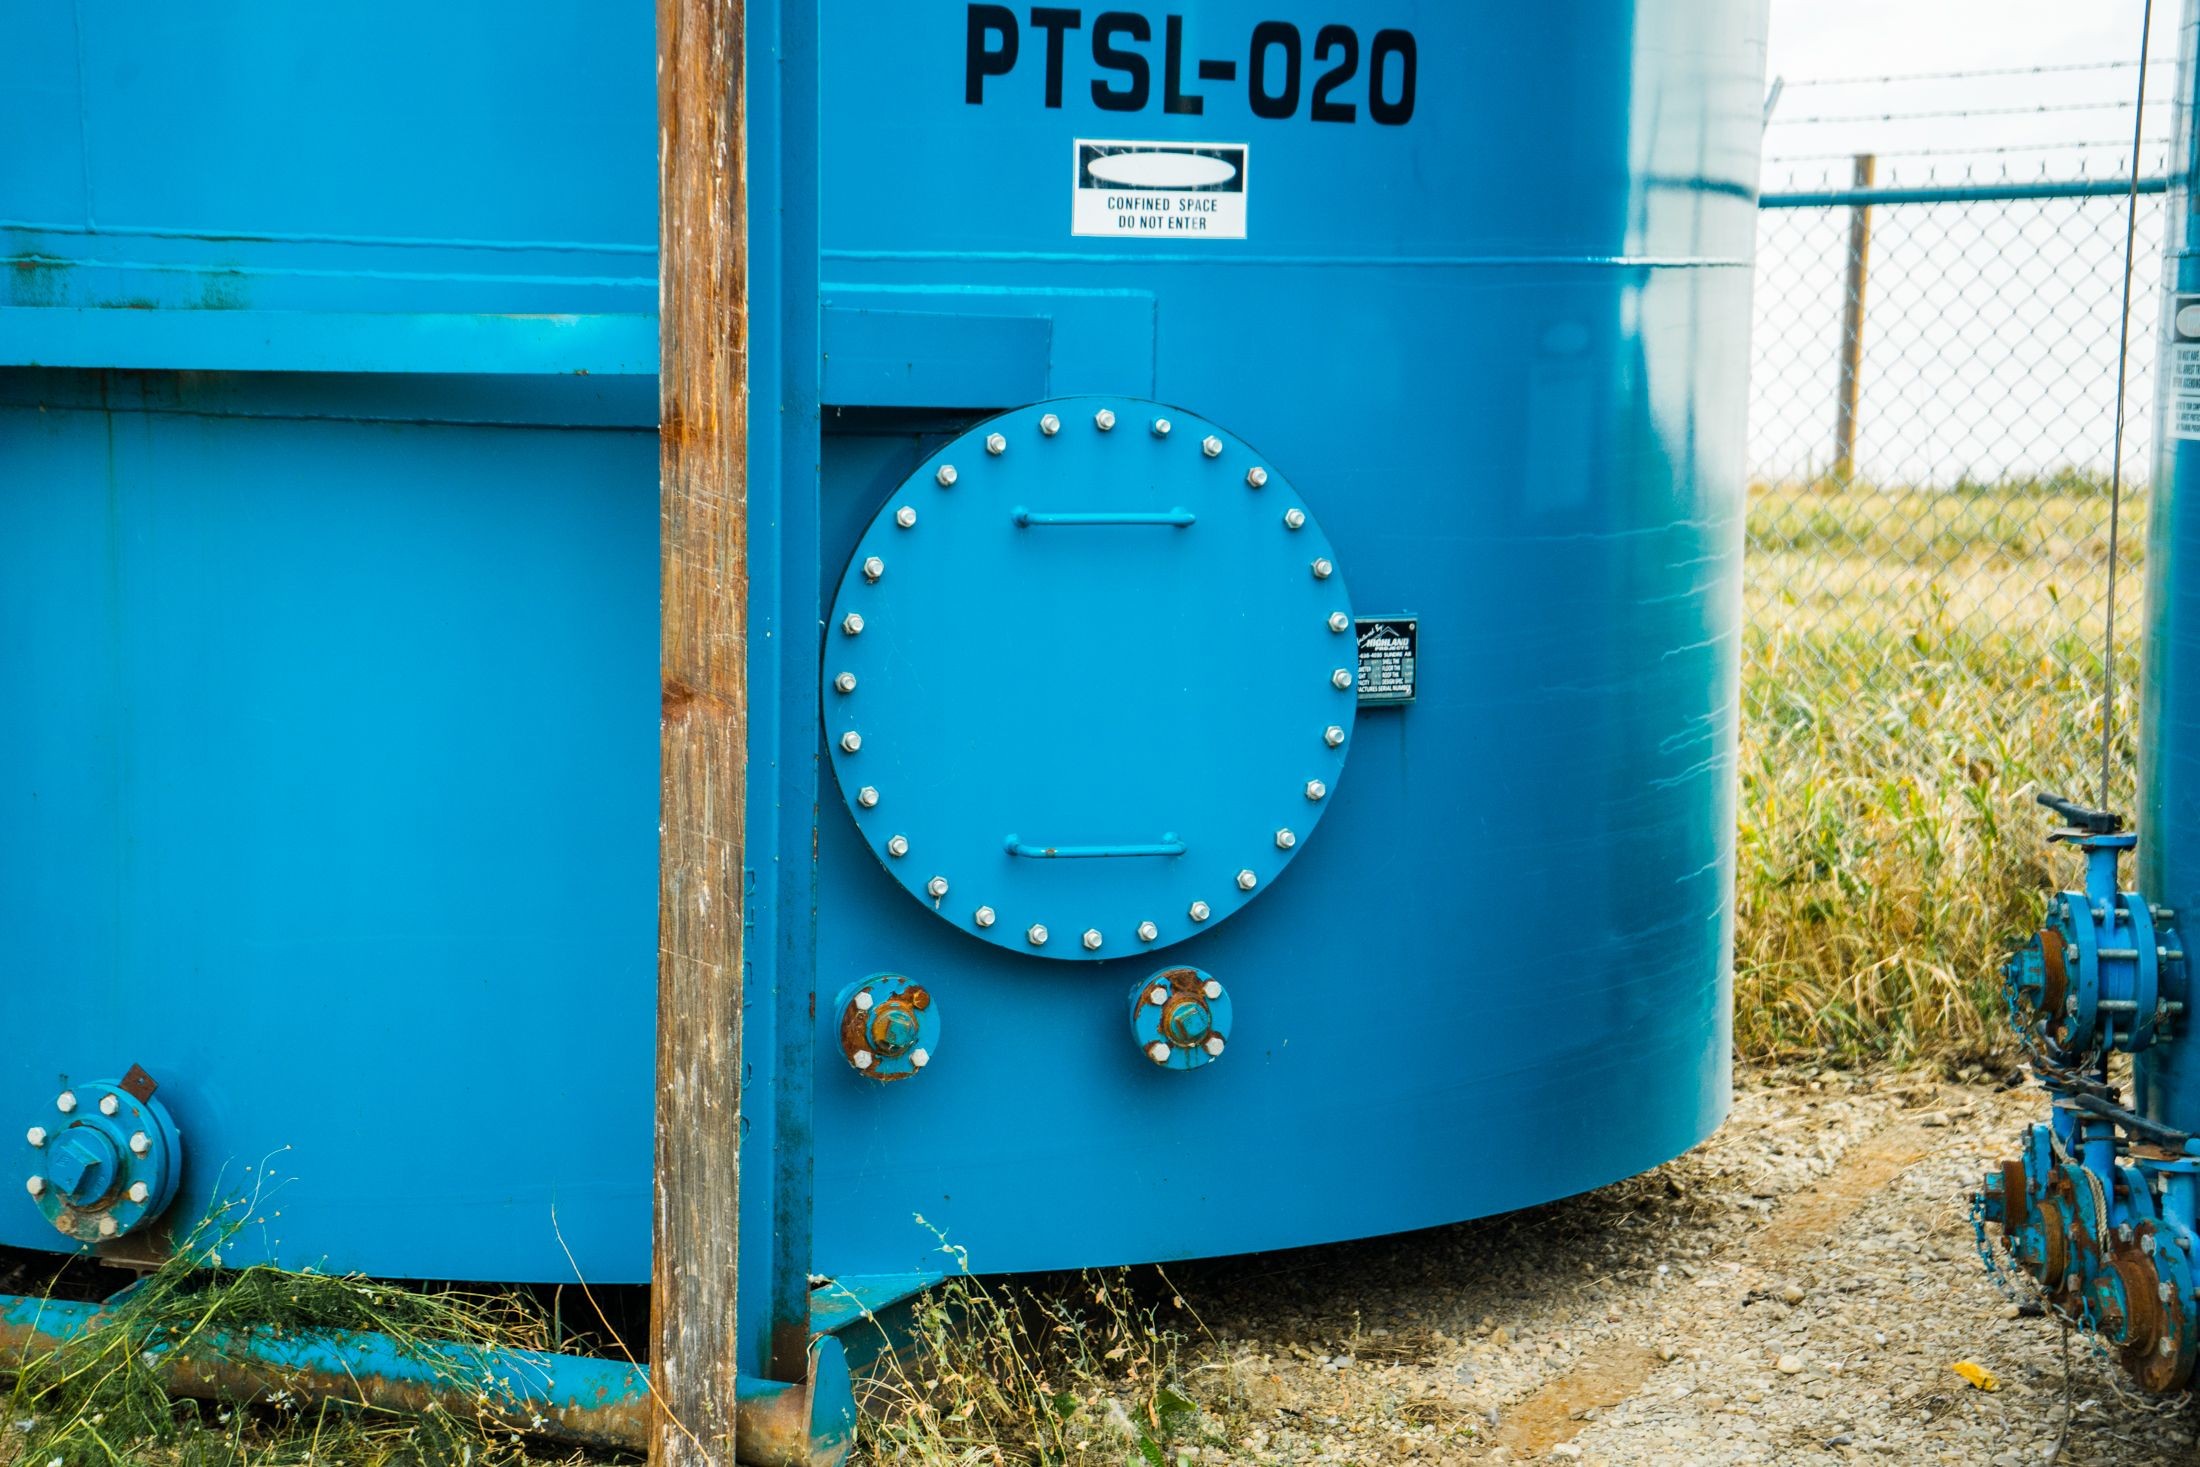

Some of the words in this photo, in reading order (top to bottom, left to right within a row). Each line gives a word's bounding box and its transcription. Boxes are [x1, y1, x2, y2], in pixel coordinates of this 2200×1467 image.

[964, 3, 1418, 126] PTSL-020
[1108, 196, 1170, 211] CONFINED
[1179, 198, 1217, 212] SPACE
[1118, 215, 1135, 229] DO
[1140, 215, 1163, 229] NOT
[1168, 216, 1206, 230] ENTER
[1366, 637, 1410, 647] HIGHLAND
